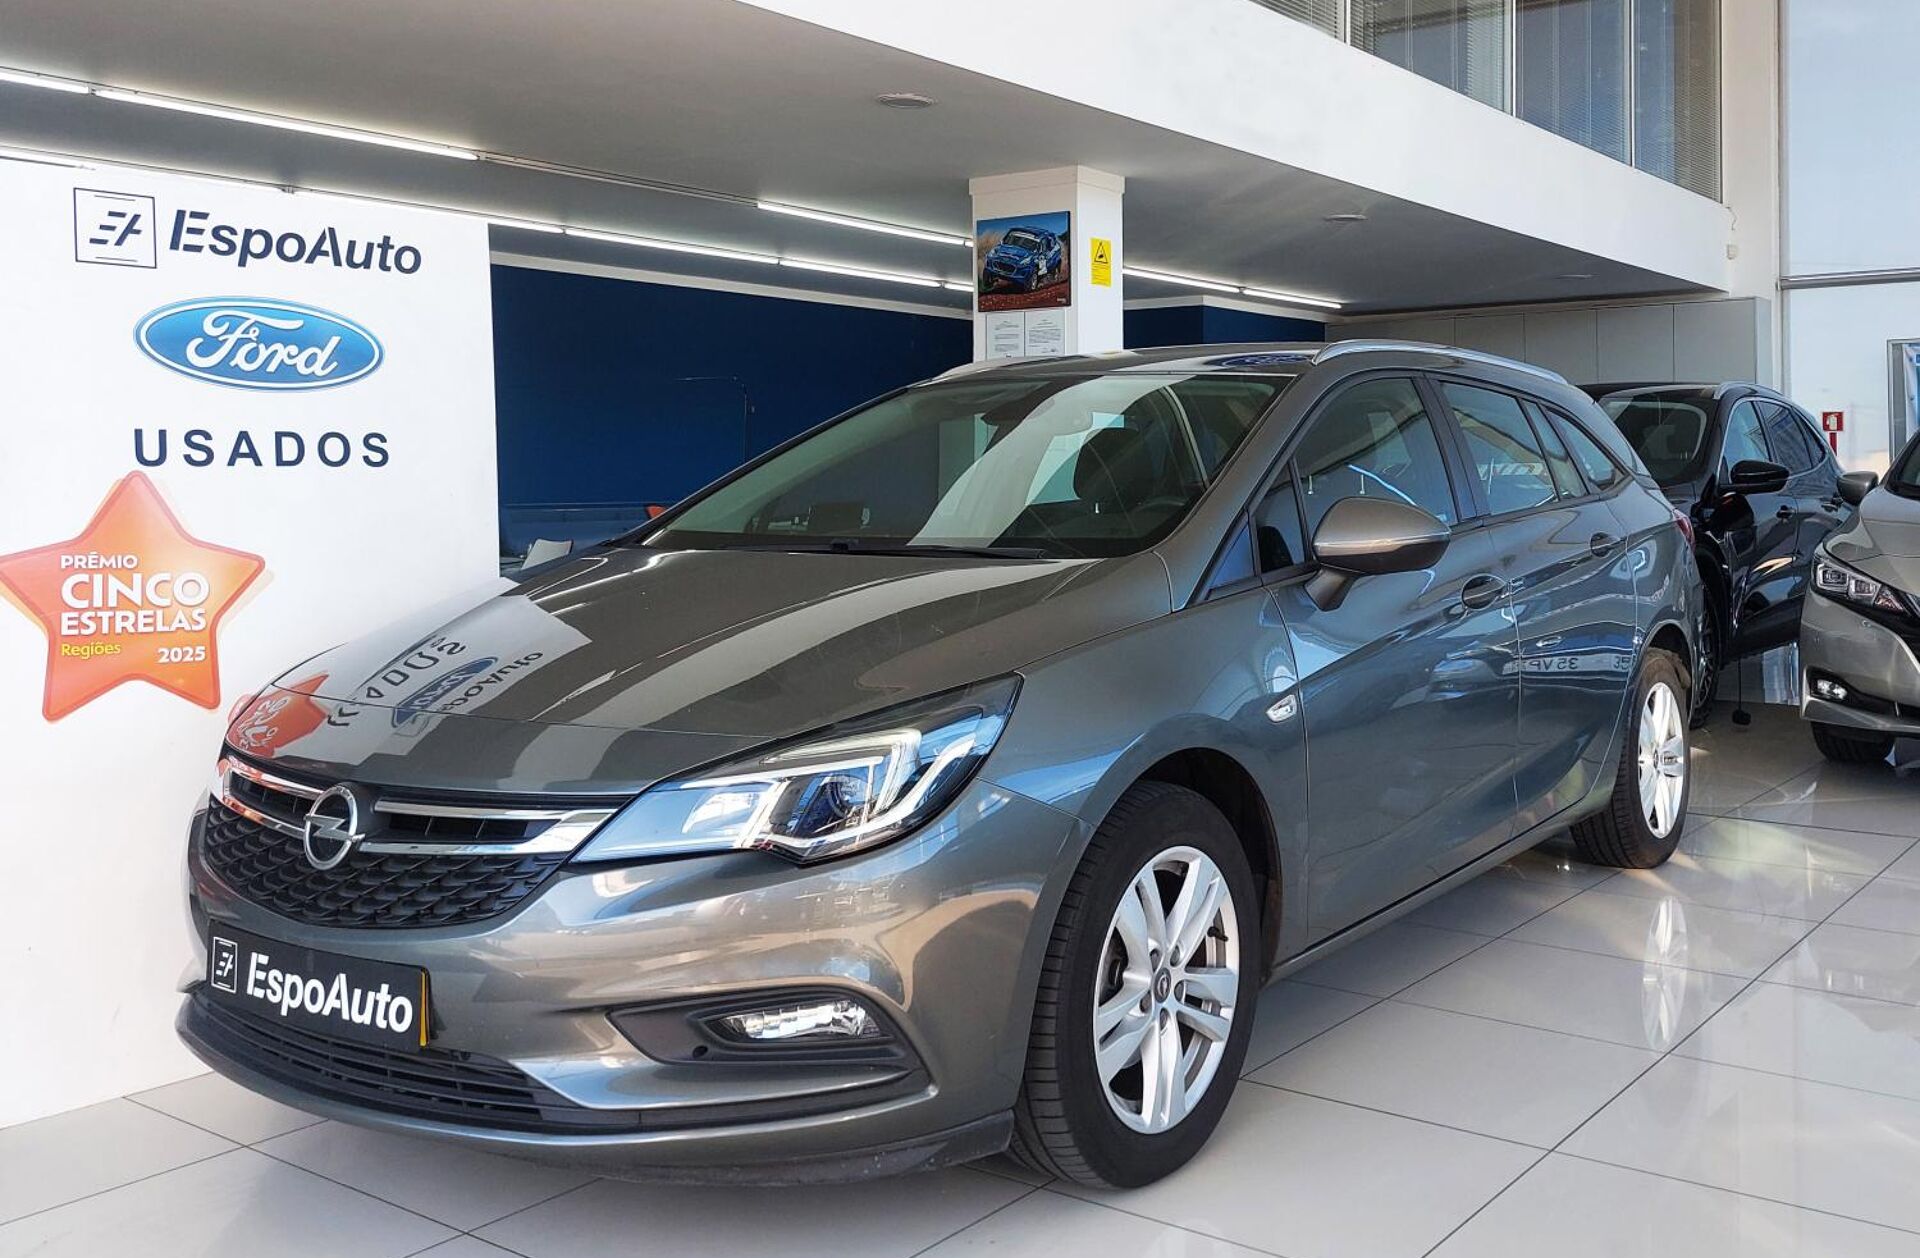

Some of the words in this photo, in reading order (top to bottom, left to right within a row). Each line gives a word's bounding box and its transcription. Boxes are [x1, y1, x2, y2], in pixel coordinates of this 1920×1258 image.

[170, 209, 422, 275] EspoAuto
[187, 311, 342, 377] Ford
[134, 429, 389, 467] USADOS
[60, 573, 209, 608] CINCO
[60, 609, 207, 635] ESTRELAS
[61, 641, 121, 660] Regiões
[157, 647, 206, 664] 2025
[248, 953, 413, 1033] EspoAuto
